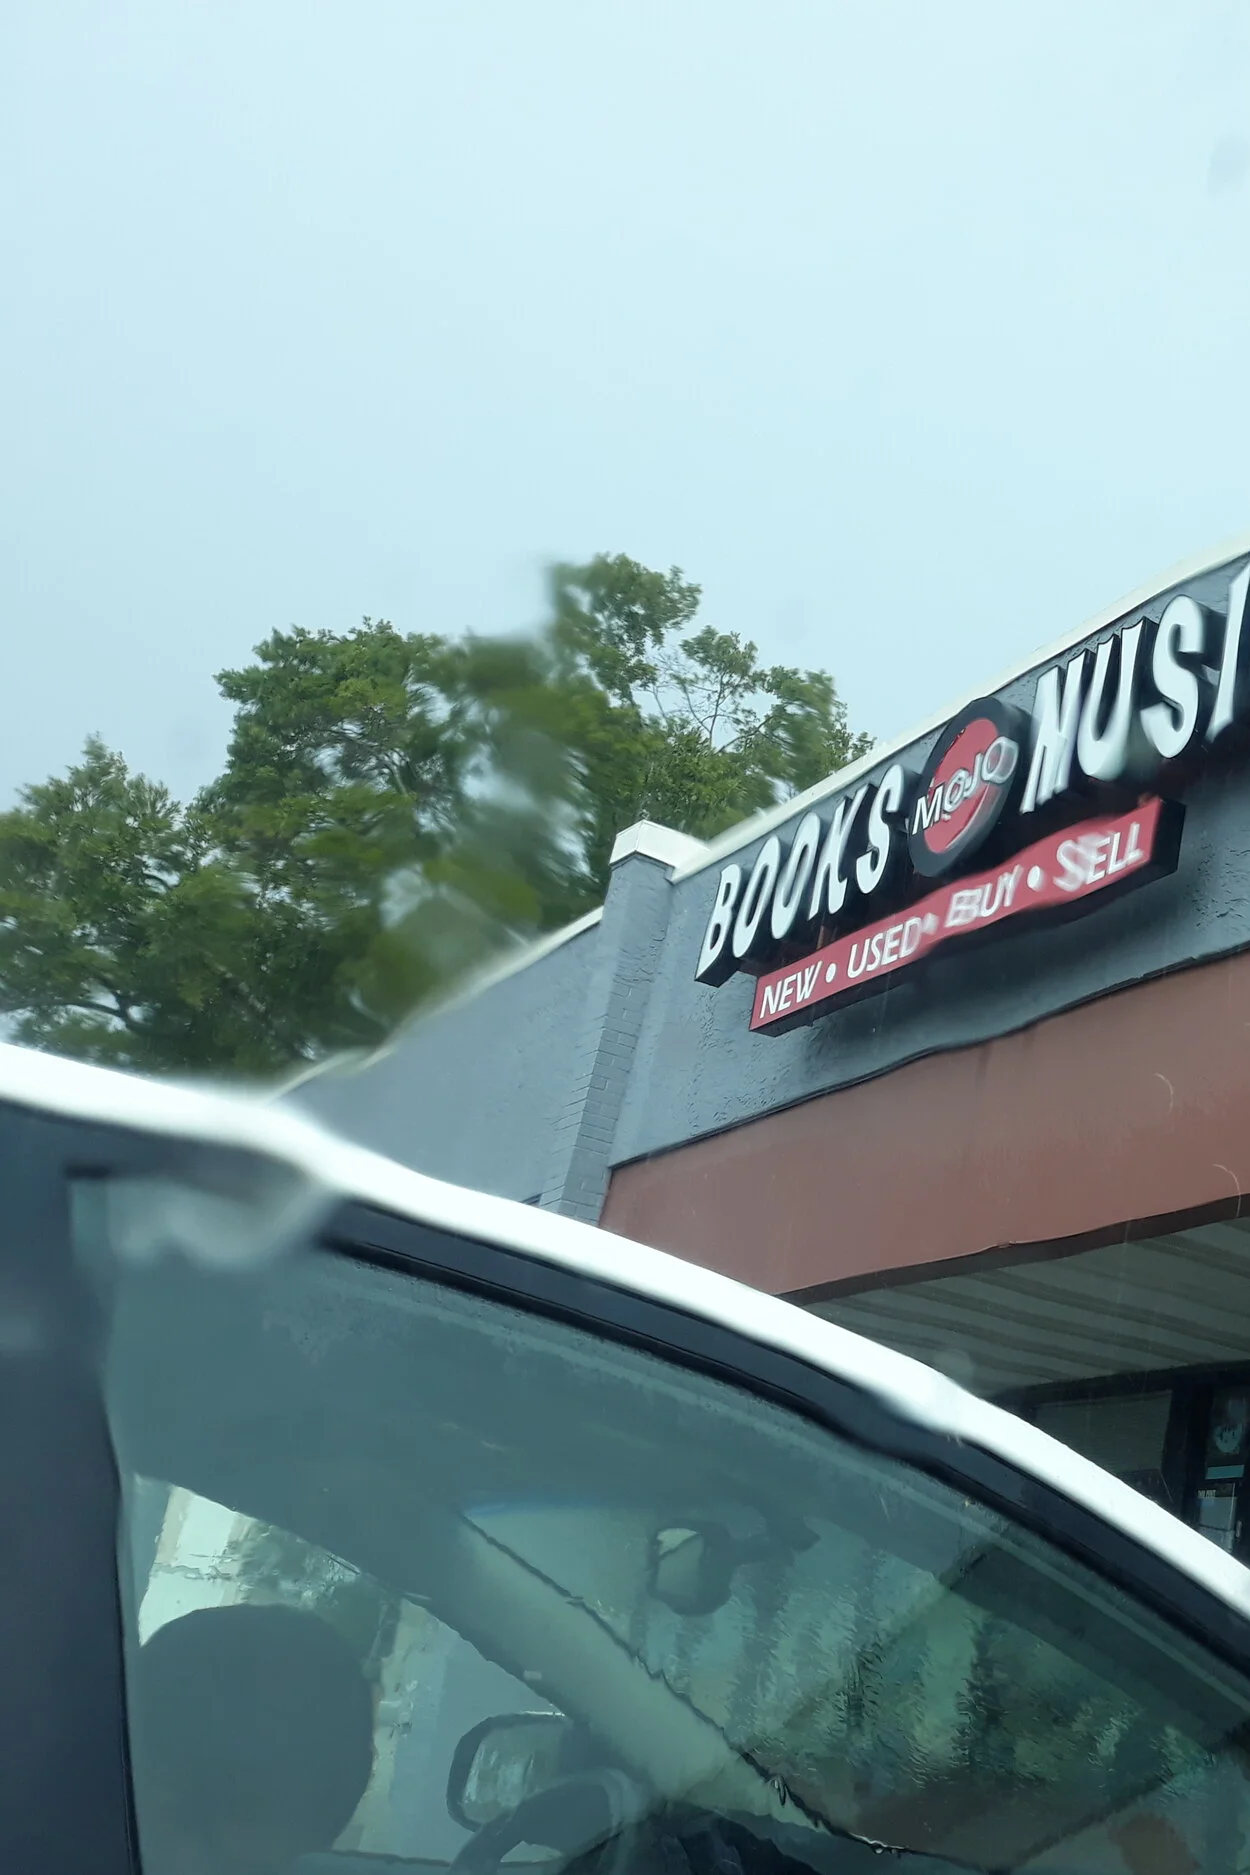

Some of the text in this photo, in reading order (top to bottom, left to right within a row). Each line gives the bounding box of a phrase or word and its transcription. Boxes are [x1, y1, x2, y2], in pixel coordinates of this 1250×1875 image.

[695, 764, 906, 980] BOOKS
[912, 736, 1020, 835] MOJO
[760, 822, 1143, 1019] NEW USED BUY SELL
